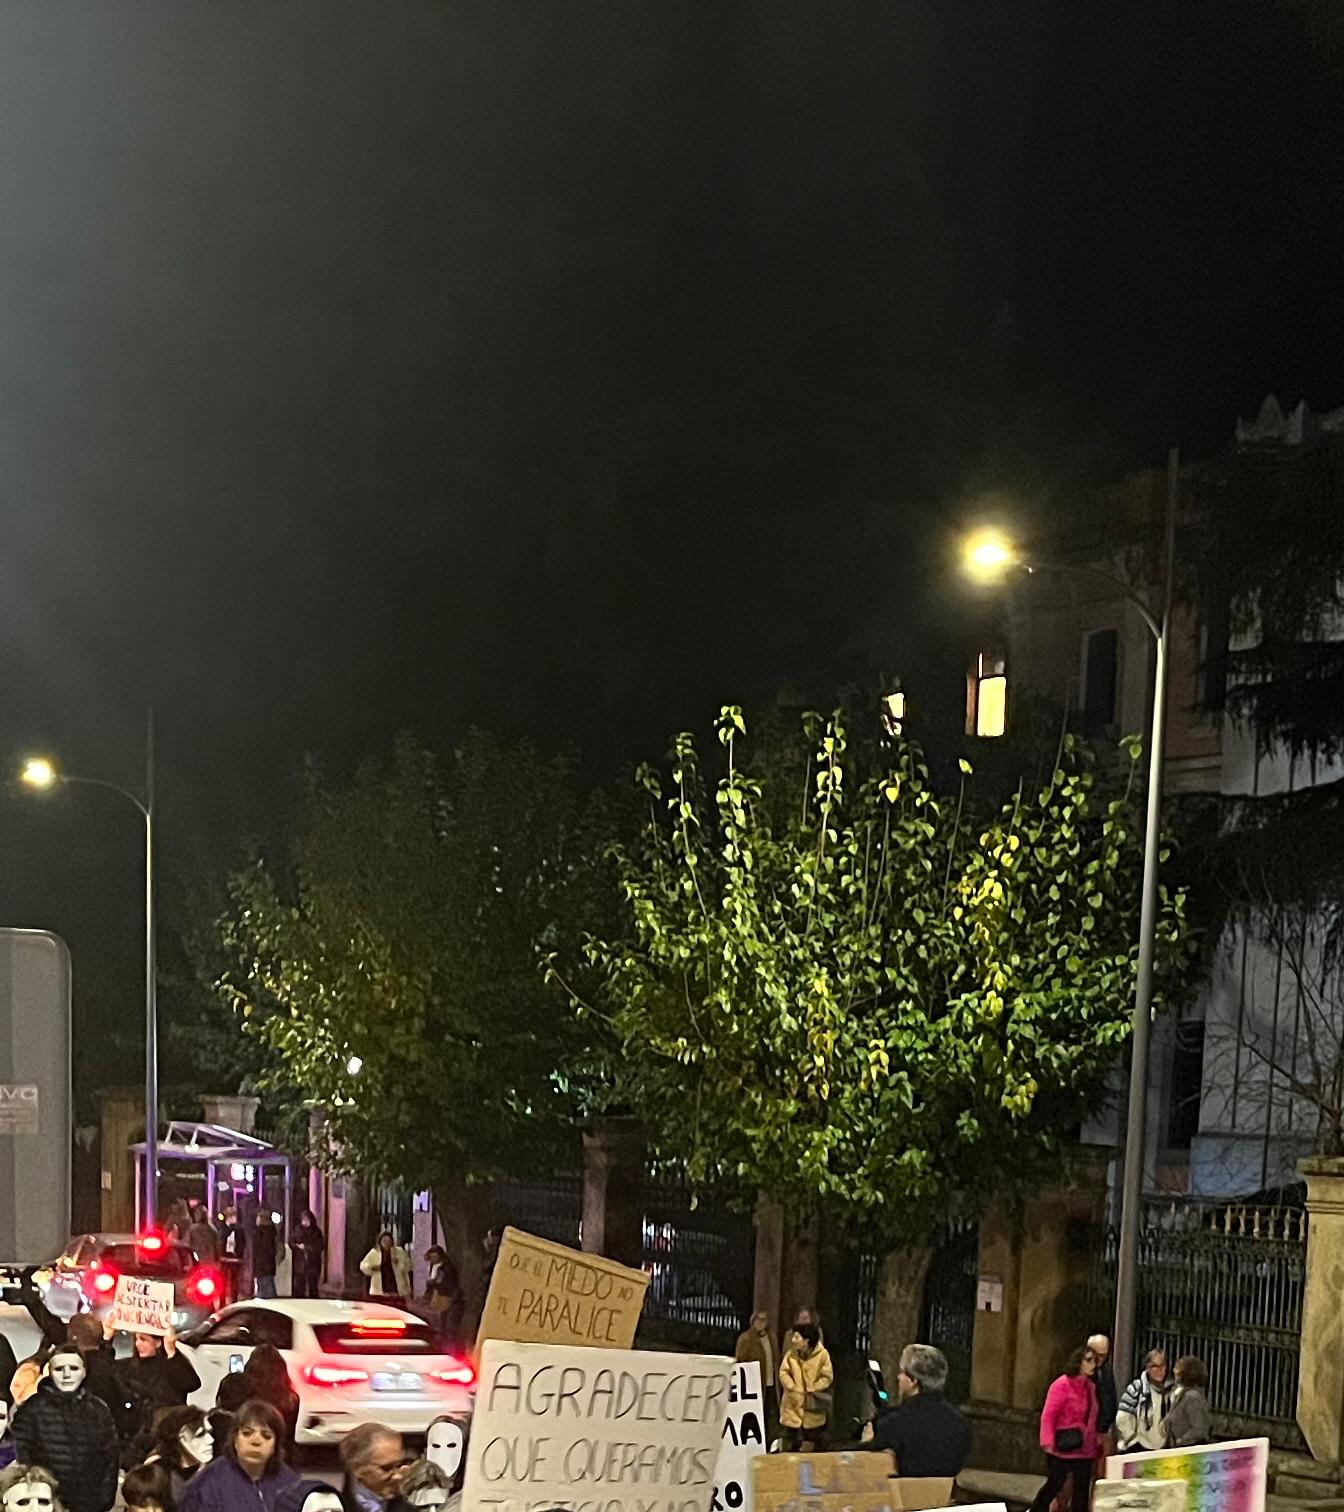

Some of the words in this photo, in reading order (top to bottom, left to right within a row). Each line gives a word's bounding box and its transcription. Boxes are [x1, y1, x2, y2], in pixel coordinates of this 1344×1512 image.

[516, 1288, 623, 1342] PARALICE
[488, 1362, 729, 1423] AGRADECER
[480, 1435, 552, 1483] QUE
[562, 1437, 711, 1486] QUERAMOS
